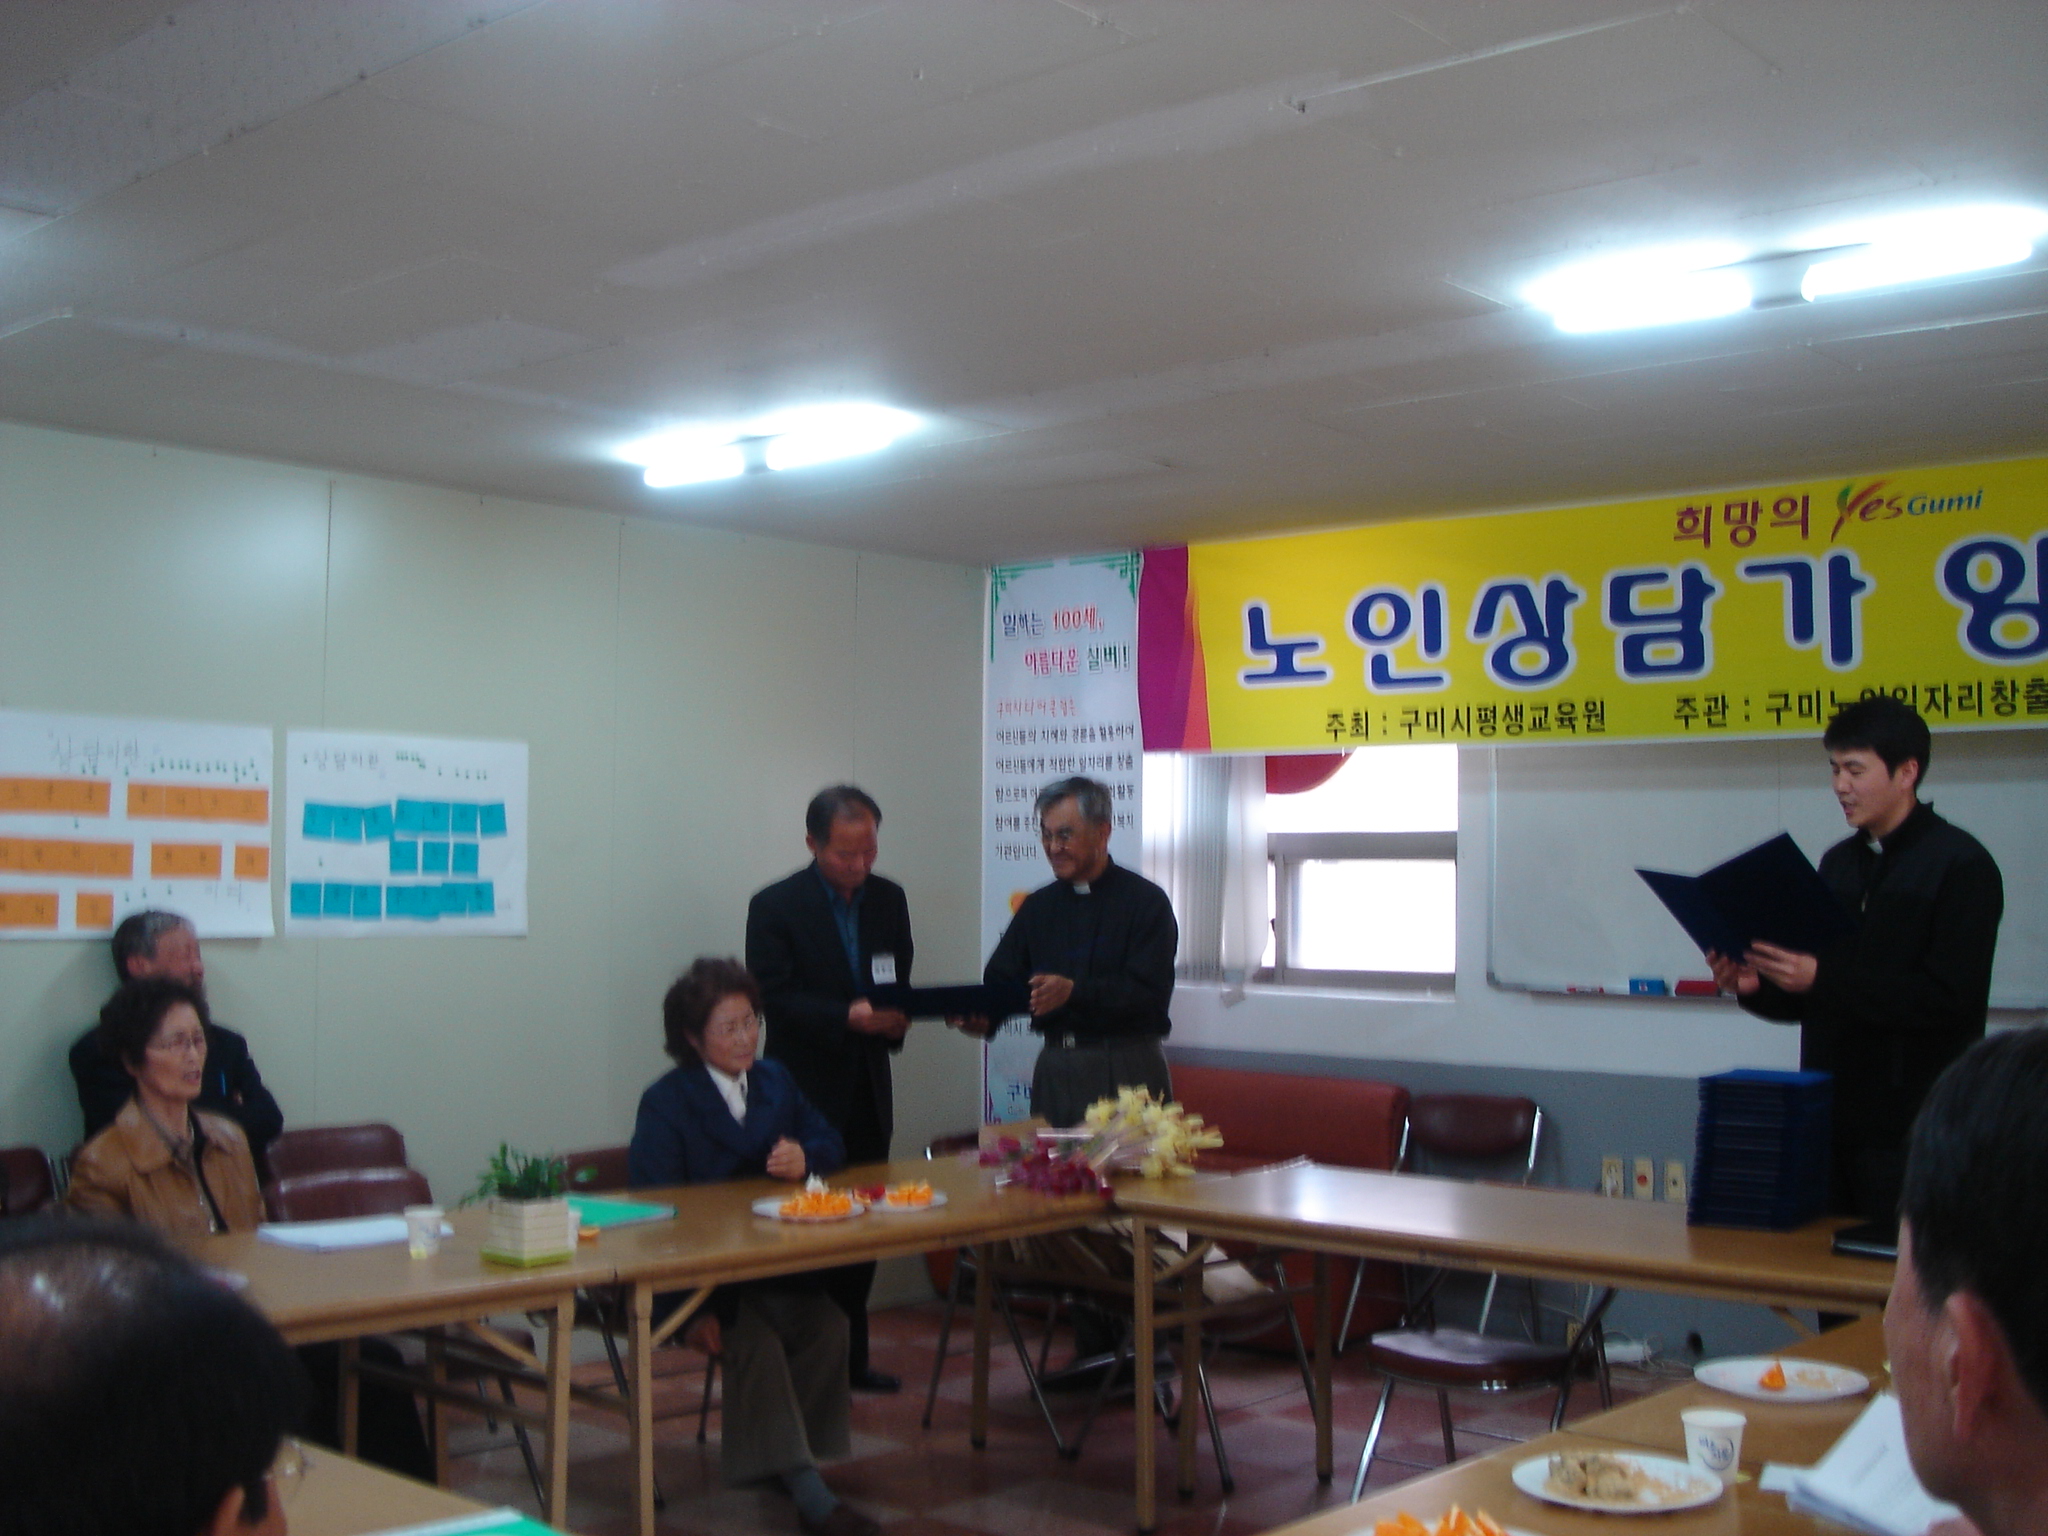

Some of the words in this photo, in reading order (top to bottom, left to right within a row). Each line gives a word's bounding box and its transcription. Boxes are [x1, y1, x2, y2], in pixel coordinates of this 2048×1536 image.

[1674, 494, 1810, 549] 희망의
[1002, 609, 1045, 638] 일하는
[1241, 553, 1869, 691] 노인상담가
[1024, 646, 1079, 676] 아름다운
[1086, 643, 1130, 673] 실버!
[1326, 704, 1369, 742] 주최
[1400, 696, 1606, 740] 구미시평생교육원
[1674, 691, 1730, 730] 주관
